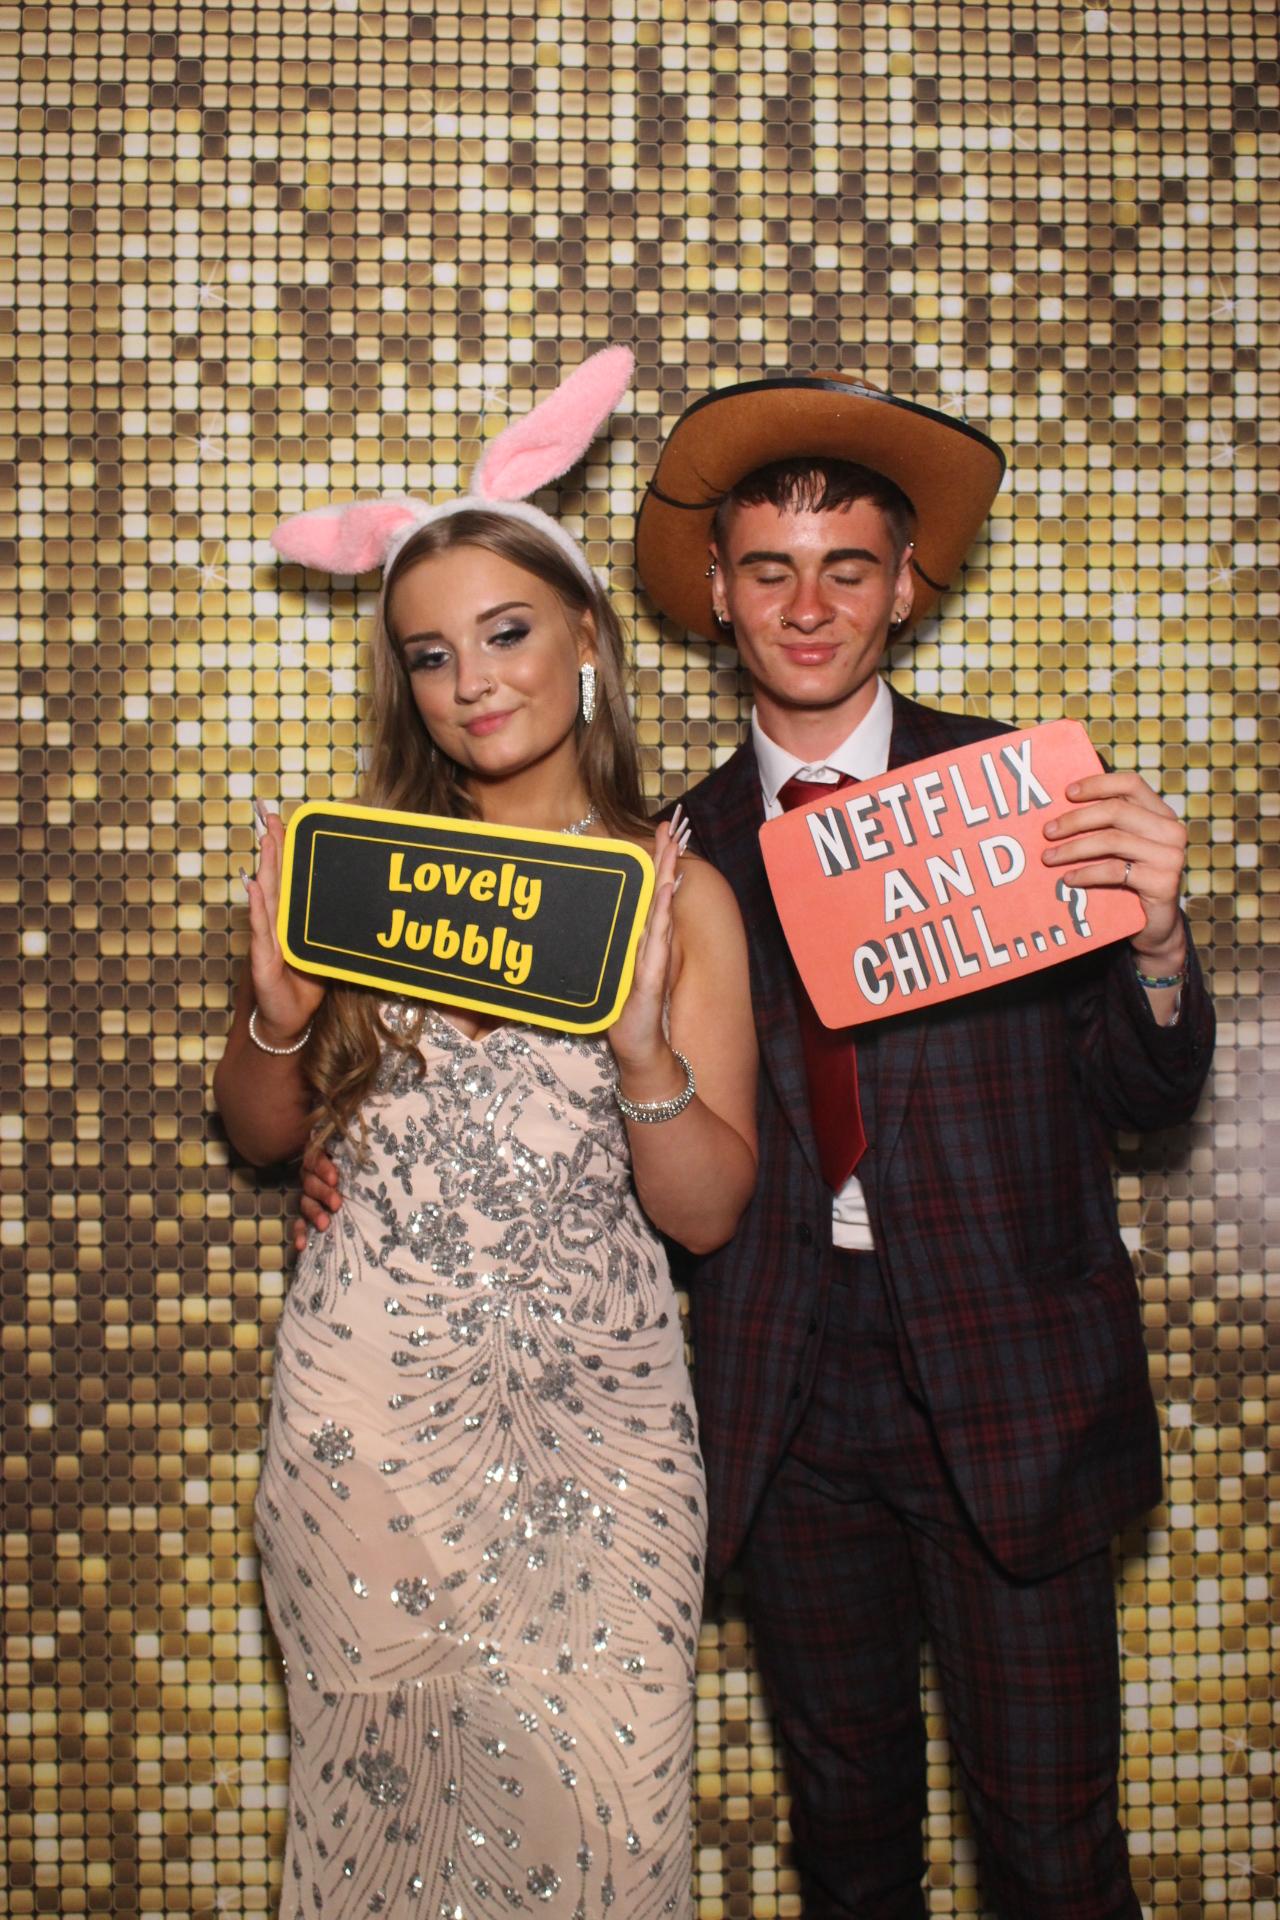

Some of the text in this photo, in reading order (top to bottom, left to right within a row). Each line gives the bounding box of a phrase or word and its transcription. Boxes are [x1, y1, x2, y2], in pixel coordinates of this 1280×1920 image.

[806, 739, 1053, 877] NETFLIX
[388, 852, 542, 921] Lovely
[884, 835, 1027, 923] AND
[376, 908, 534, 986] Jubbly
